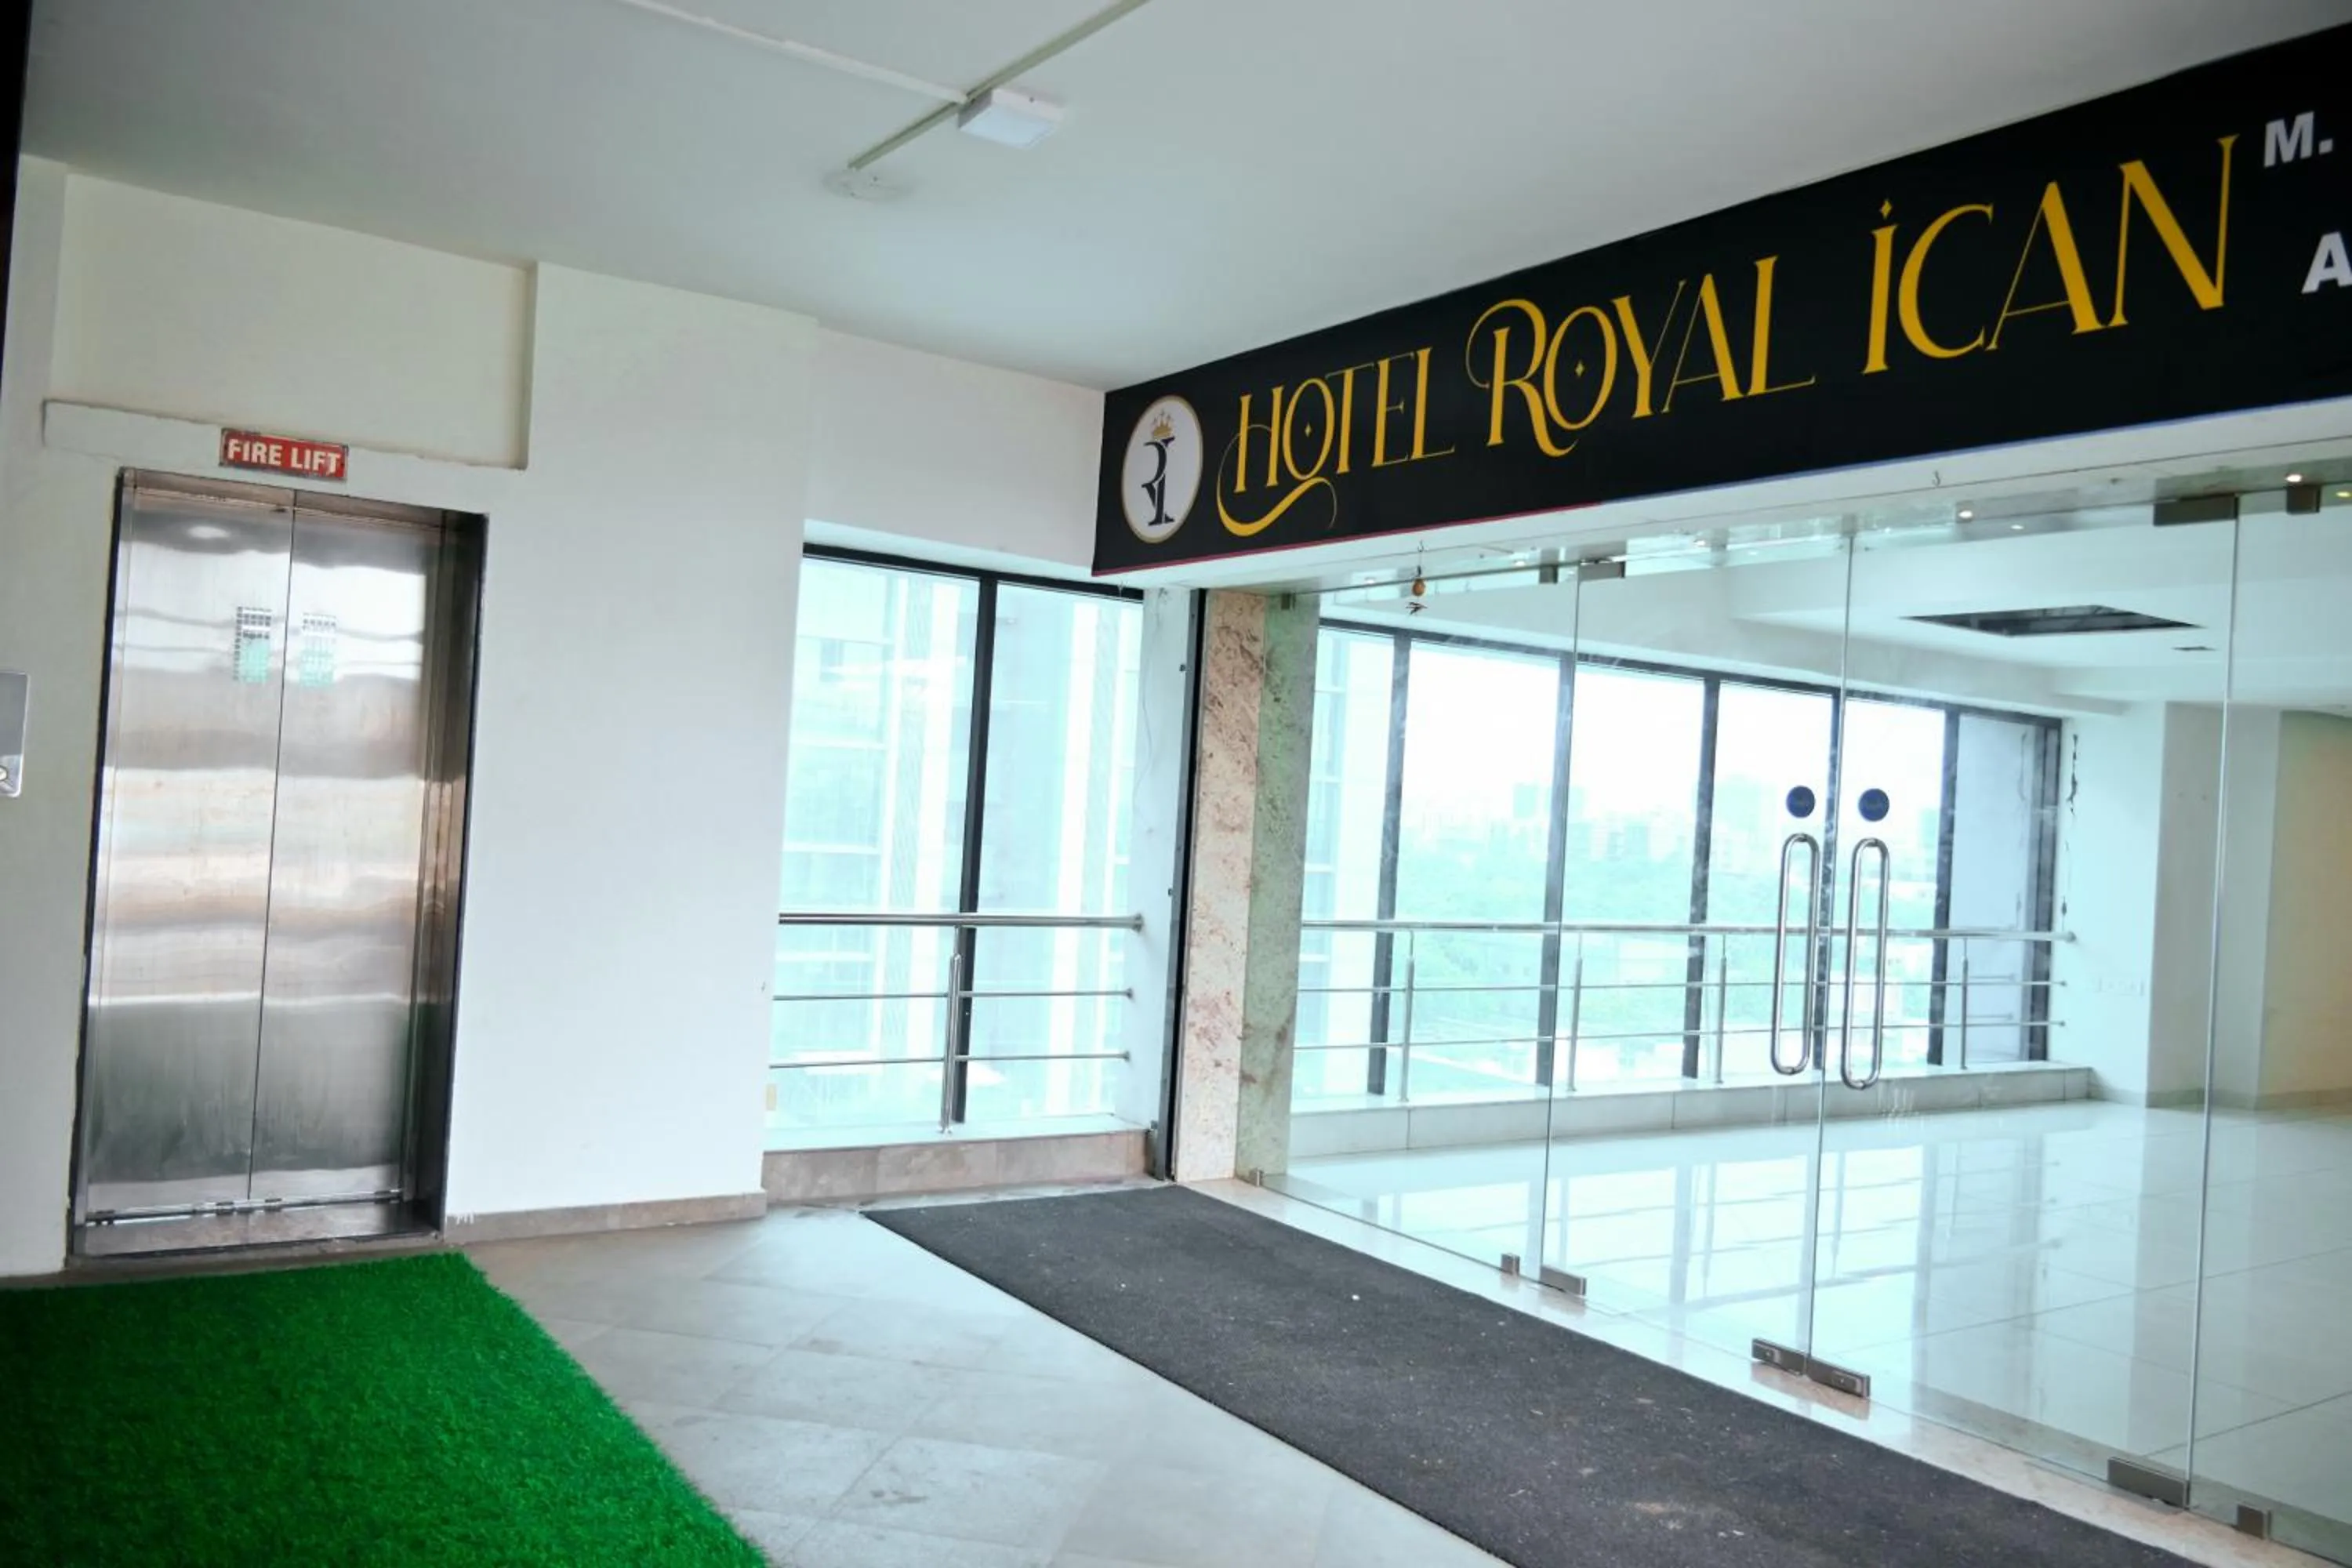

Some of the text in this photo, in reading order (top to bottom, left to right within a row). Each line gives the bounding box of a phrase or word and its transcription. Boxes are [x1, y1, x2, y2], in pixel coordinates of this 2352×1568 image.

[2264, 111, 2332, 167] M.
[1216, 347, 1455, 537] HOTEL
[1465, 255, 1815, 458] ROYAL
[227, 438, 341, 474] FIRE LIFT
